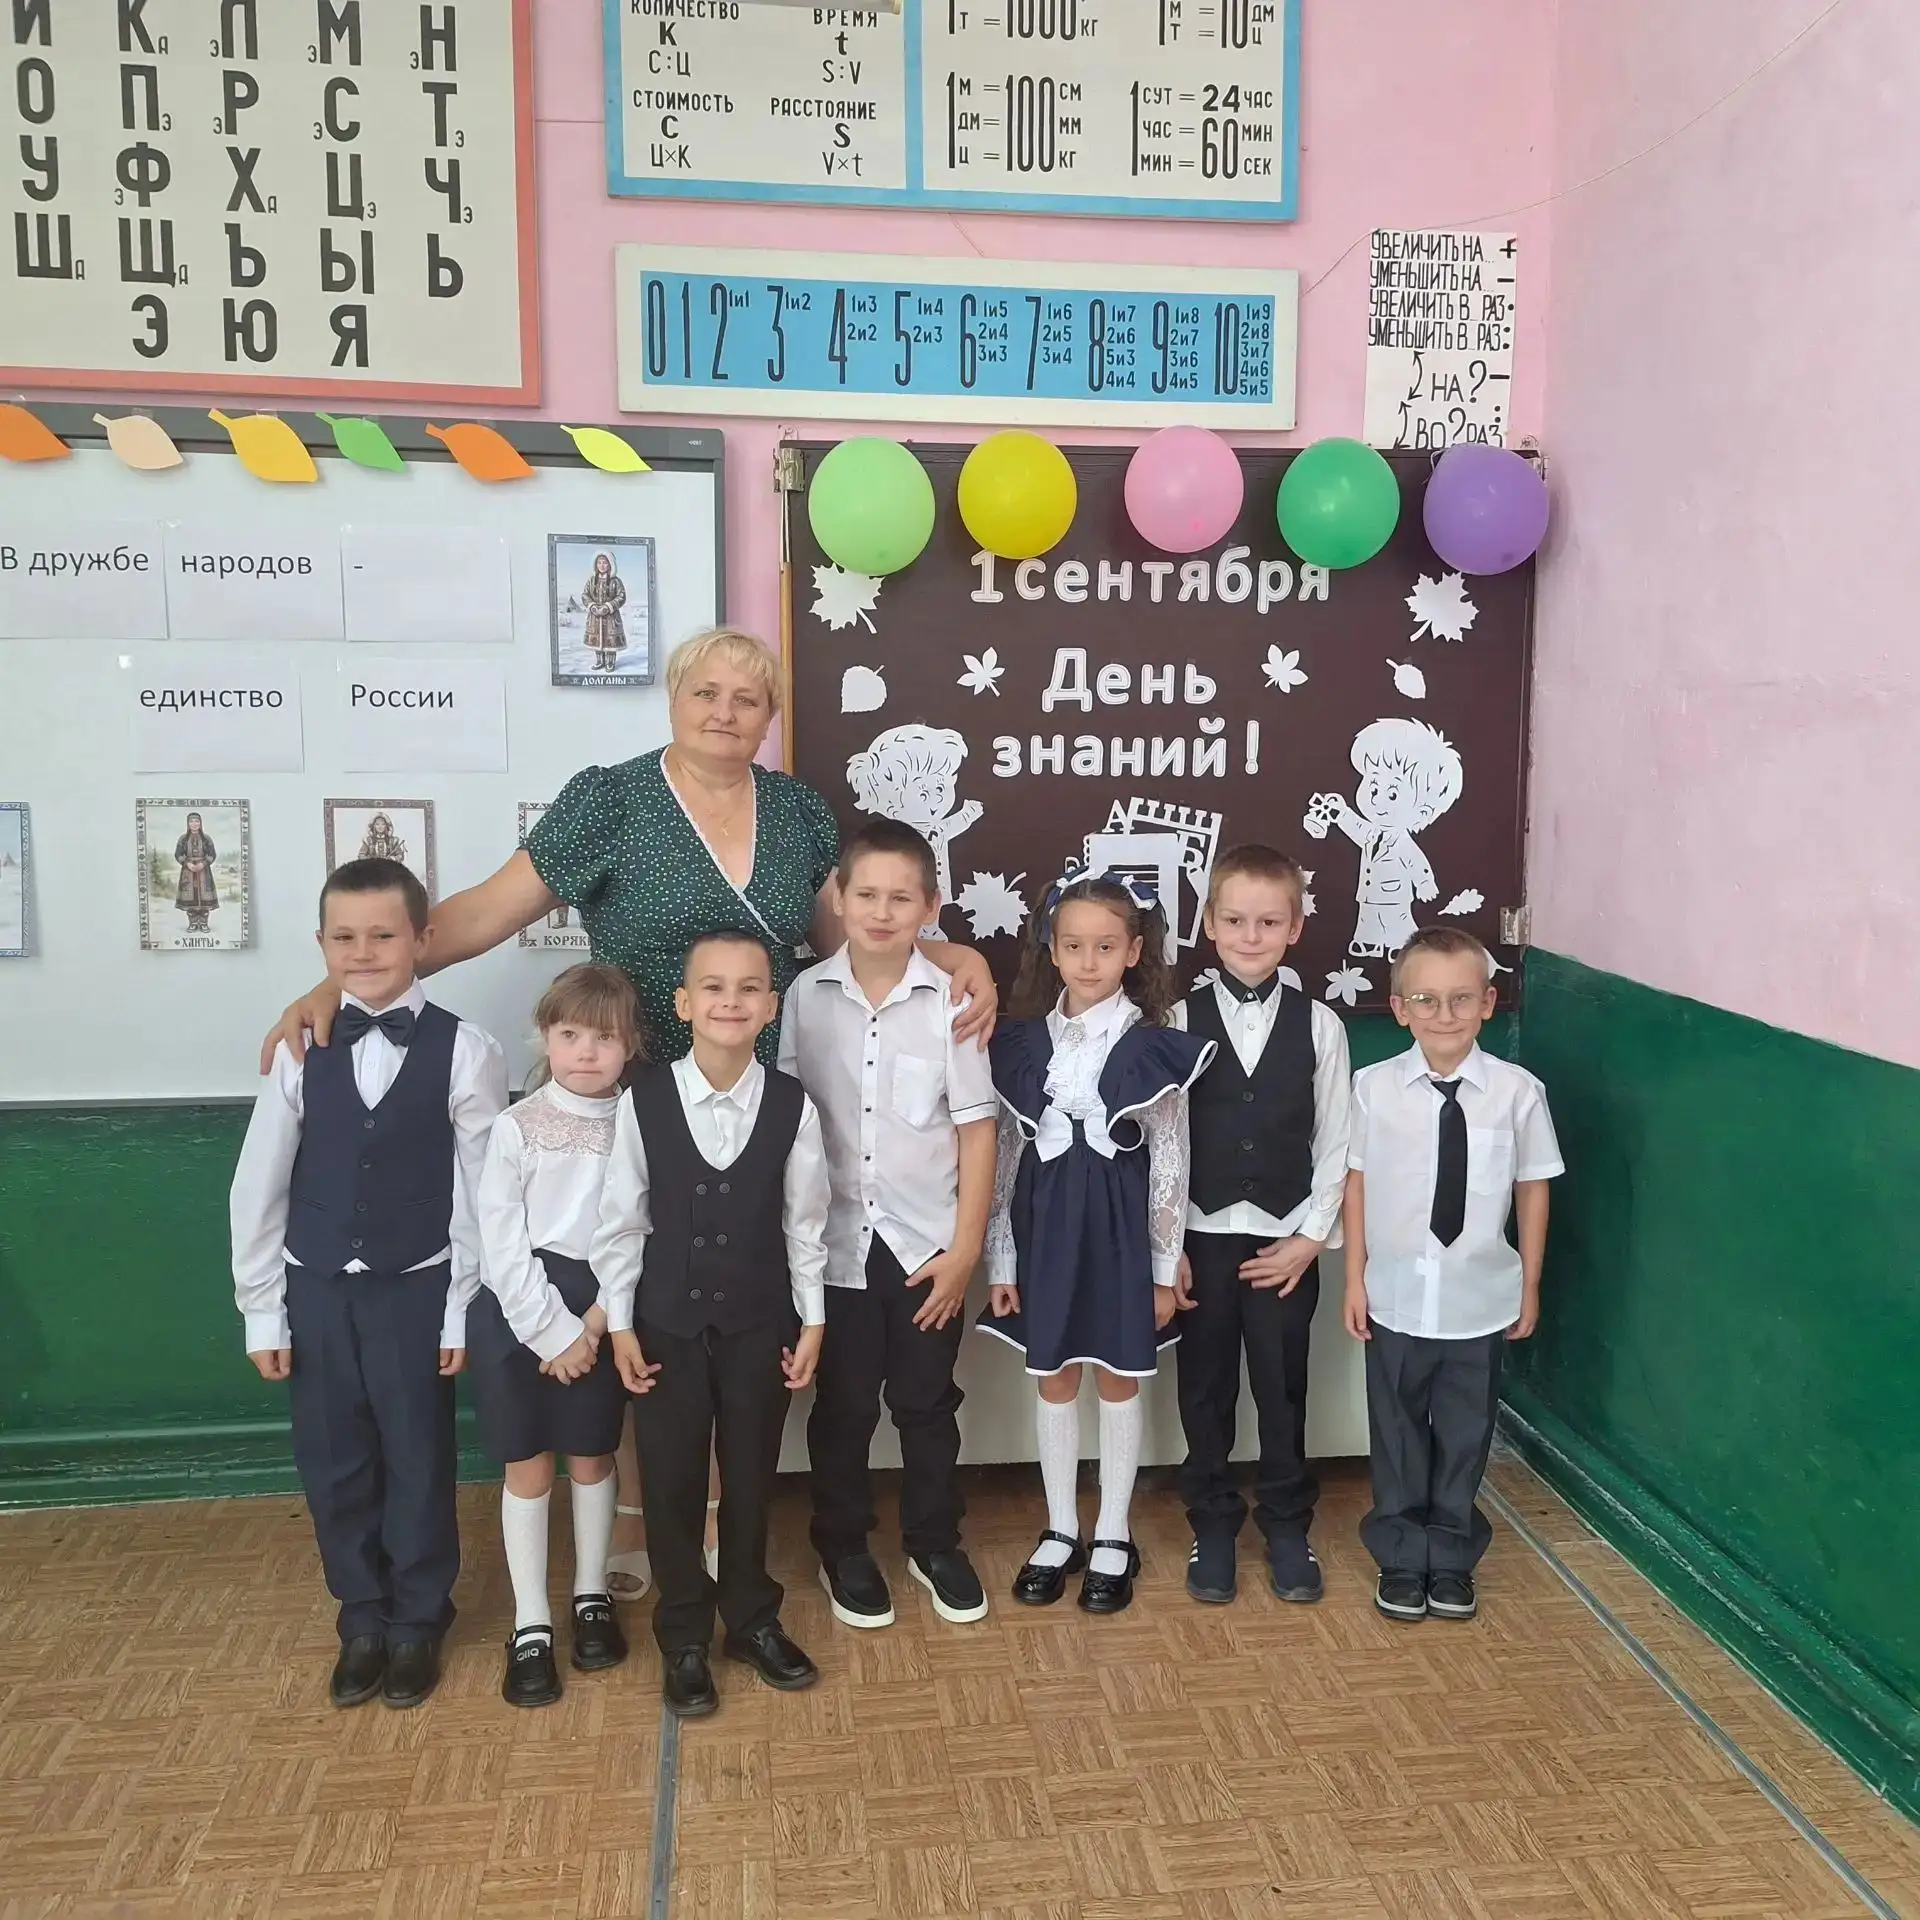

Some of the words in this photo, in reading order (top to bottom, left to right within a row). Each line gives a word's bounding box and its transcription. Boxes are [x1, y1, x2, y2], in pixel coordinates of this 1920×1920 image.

[813, 7, 878, 28] ВРЕМЯ
[1080, 18, 1099, 37] КГ
[1251, 4, 1274, 23] ДМ
[16, 57, 55, 125] О
[633, 89, 734, 114] СТОИМОСТЬ
[1142, 86, 1173, 105] СУТ
[1202, 83, 1241, 113] 24
[1243, 90, 1273, 109] ЧАС
[770, 97, 877, 120] РАССТОЯНИЕ
[957, 111, 980, 131] ДМ
[1059, 116, 1082, 135] ММ
[1005, 74, 1055, 173] 100
[1059, 82, 1082, 101] СМ
[832, 122, 851, 149] S
[1142, 120, 1172, 139] ЧАС
[1201, 117, 1239, 180] 60
[1241, 123, 1273, 142] МИН
[19, 134, 59, 202] У
[1059, 150, 1077, 169] КГ
[1140, 153, 1172, 172] МИН
[1243, 157, 1272, 176] СЕК
[223, 222, 267, 288] Ъ
[319, 227, 375, 295] Ы
[426, 232, 464, 299] Ь
[1371, 228, 1459, 262] УВЕЛИЧИТЬ
[1370, 260, 1459, 291] УМЕНЬШИТЬ
[1369, 288, 1454, 320] УВЕЛИЧИТЬ
[131, 293, 169, 359] Э
[222, 297, 278, 363] Ю
[329, 304, 369, 368] Я
[648, 280, 665, 377] 0
[682, 282, 691, 378] 1
[710, 283, 728, 379] 2
[767, 285, 784, 382] 3
[828, 288, 847, 384] 4
[895, 291, 911, 386] 5
[960, 293, 976, 388] 6
[1025, 296, 1041, 390] 7
[1089, 299, 1105, 392] 8
[1152, 301, 1169, 394] 9
[1214, 303, 1239, 395] 10
[1368, 317, 1453, 350] УМЕНЬШИТЬ
[0, 546, 18, 570] В
[29, 546, 149, 576] дружбе
[181, 554, 312, 579] народов
[1041, 647, 1217, 713] День
[140, 688, 283, 712] единство
[350, 684, 454, 708] России
